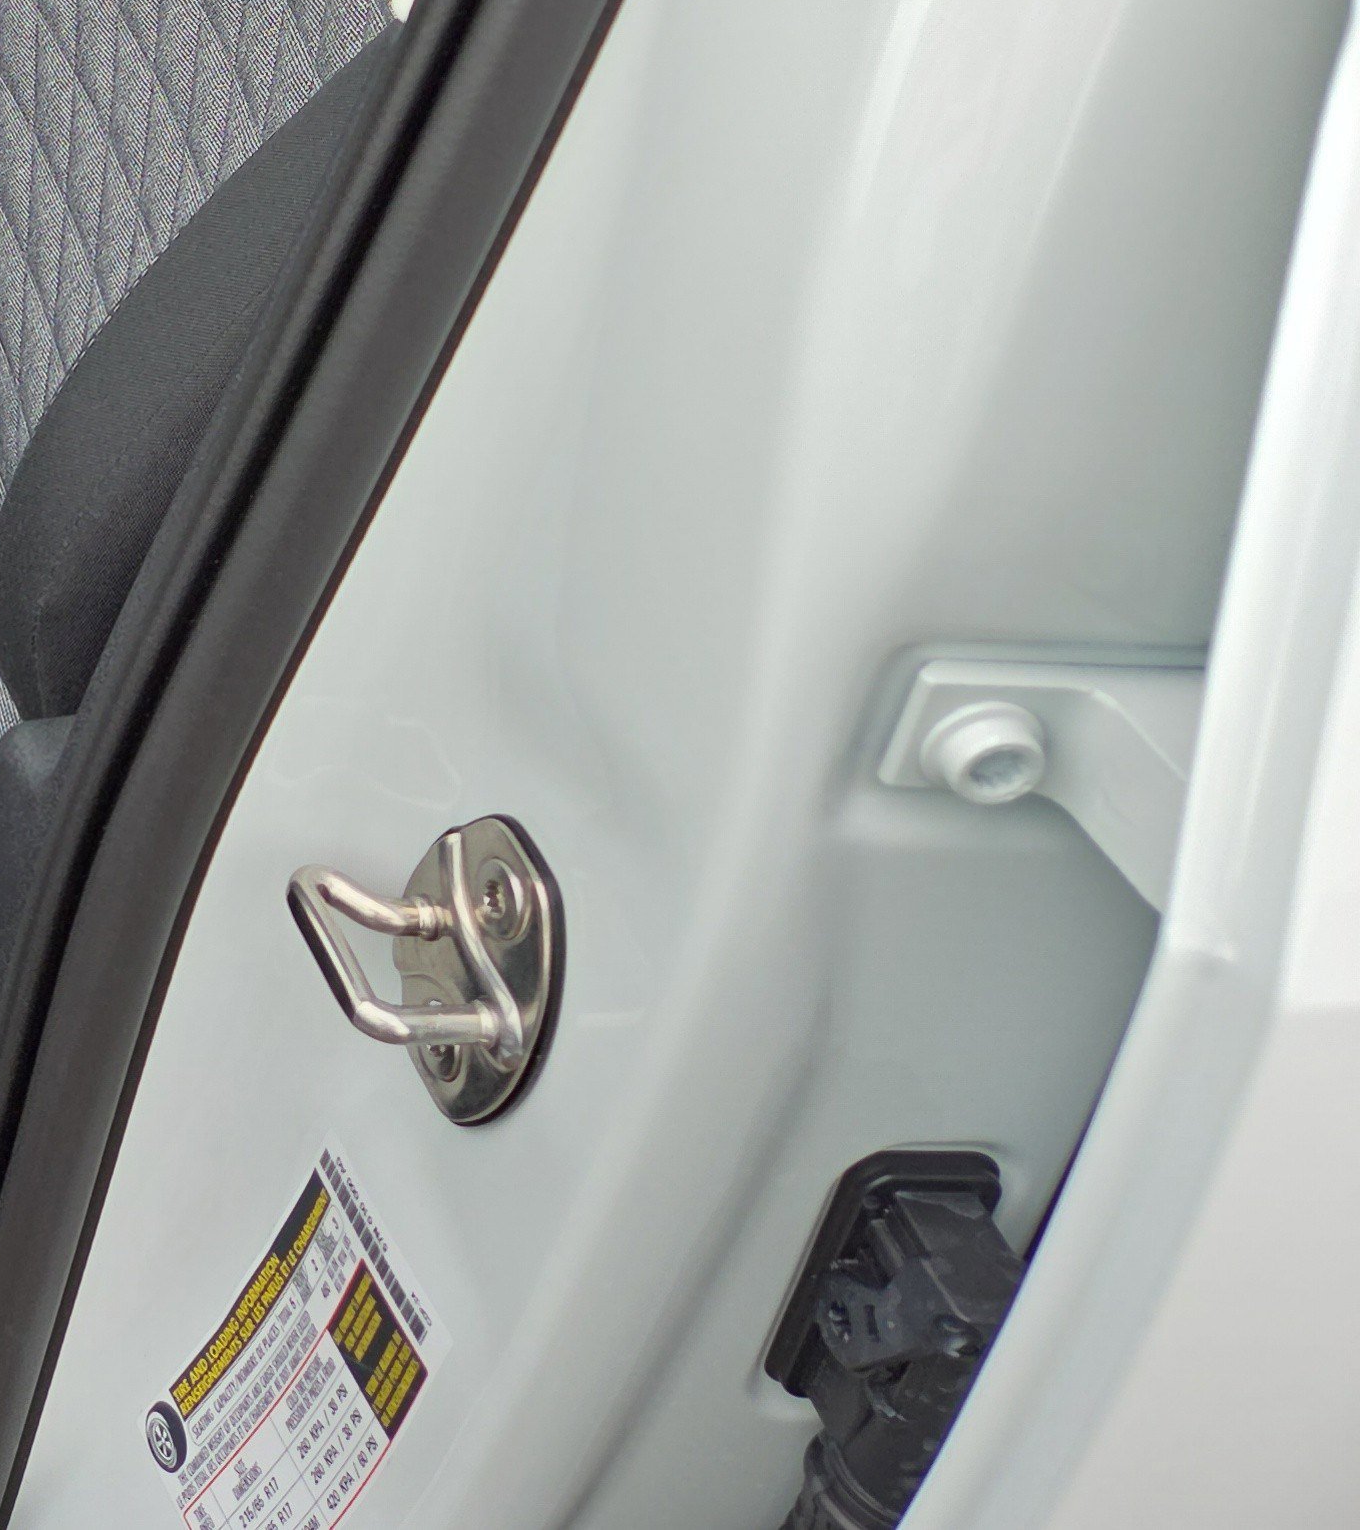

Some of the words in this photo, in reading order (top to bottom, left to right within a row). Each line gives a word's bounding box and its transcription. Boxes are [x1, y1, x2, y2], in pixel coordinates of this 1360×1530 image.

[178, 1333, 243, 1418] RENSEIGNEMENTS
[238, 1314, 255, 1344] SUR
[250, 1298, 266, 1325] LES
[260, 1269, 284, 1310] PNEUS
[292, 1185, 330, 1258] CHARGEMENT
[171, 1373, 192, 1407] TIRE
[187, 1352, 209, 1388] AND
[204, 1312, 240, 1367] LOADING
[234, 1249, 280, 1324] INFORMATION
[308, 1415, 325, 1443] KPA
[322, 1440, 340, 1468] KPA
[262, 1475, 279, 1501] R17
[339, 1472, 355, 1494] KPA
